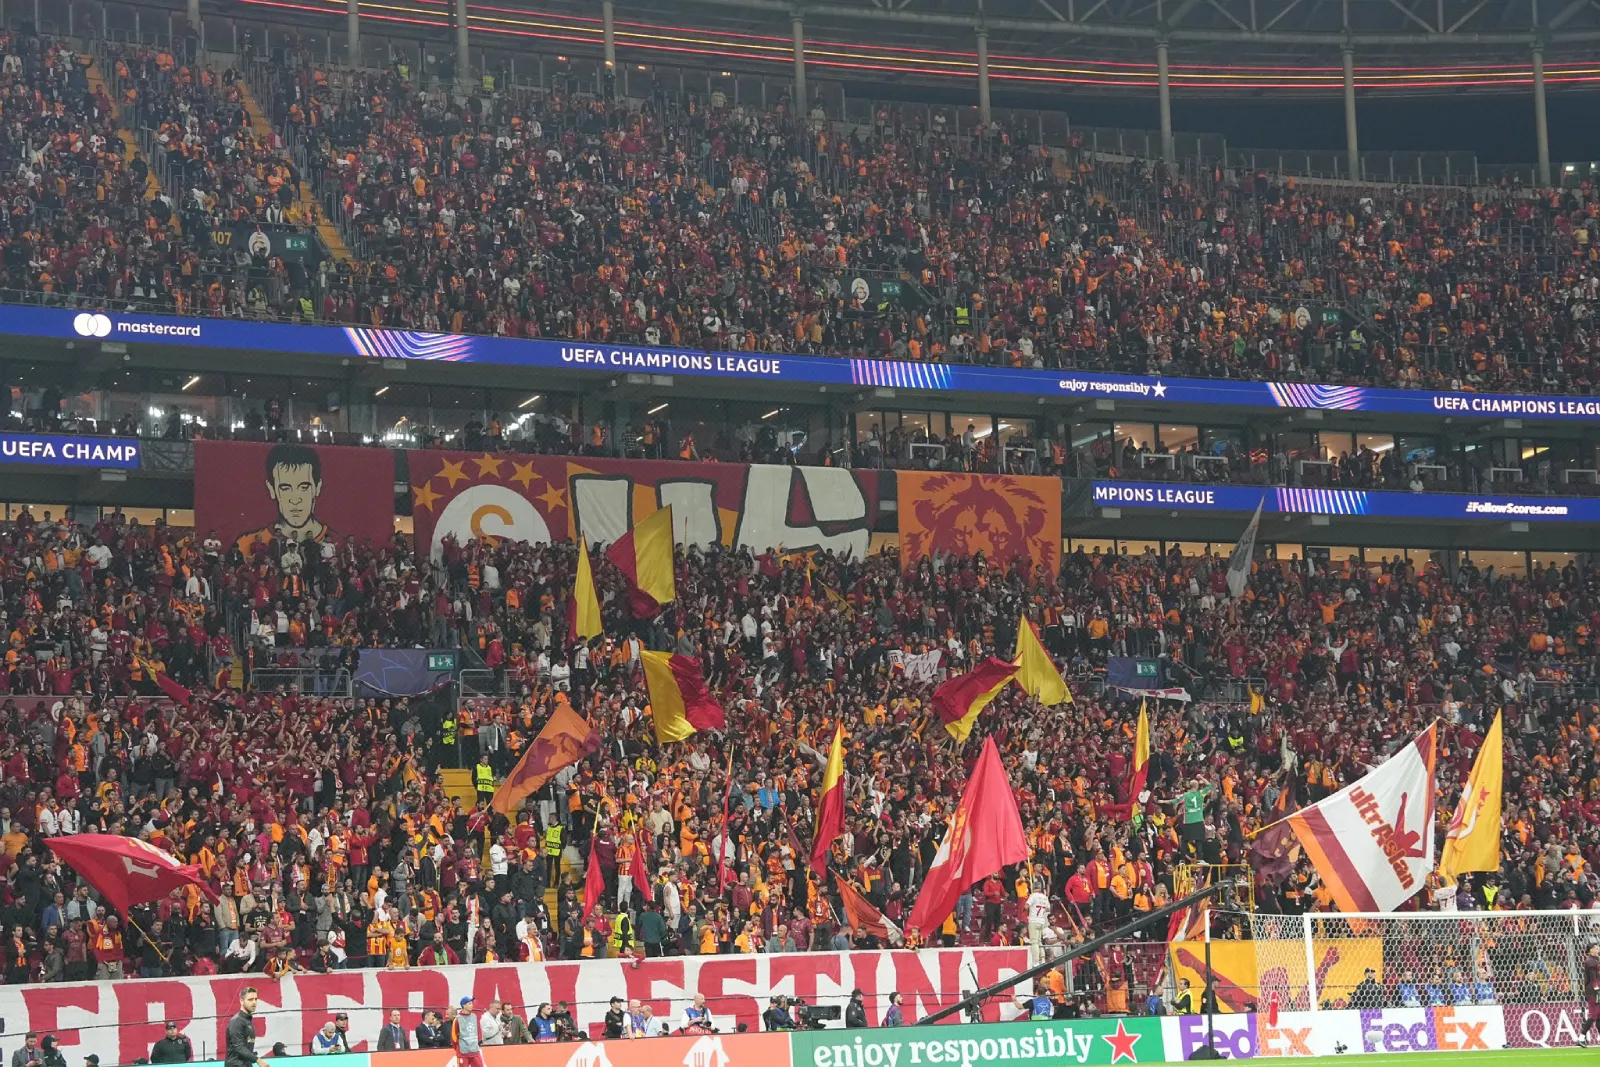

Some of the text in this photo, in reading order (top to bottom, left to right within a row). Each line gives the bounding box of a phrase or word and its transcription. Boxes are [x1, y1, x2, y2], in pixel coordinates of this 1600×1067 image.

[211, 231, 232, 245] 107
[117, 321, 200, 337] mastercard
[561, 347, 781, 374] UEFA CHAMPIONS LEAGUE
[1059, 379, 1151, 396] enjoy responsibly
[1433, 396, 1469, 411] UEFA
[1472, 398, 1556, 414] CHAMPIONS
[2, 440, 137, 461] UEFA CHAMP
[1093, 486, 1214, 504] MPIONS LEAGUE
[1472, 502, 1568, 515] FollowScores.com
[1179, 1012, 1314, 1060] FedEx
[1360, 1006, 1489, 1053] FedEx
[813, 1028, 1094, 1067] enjoy responsibly
